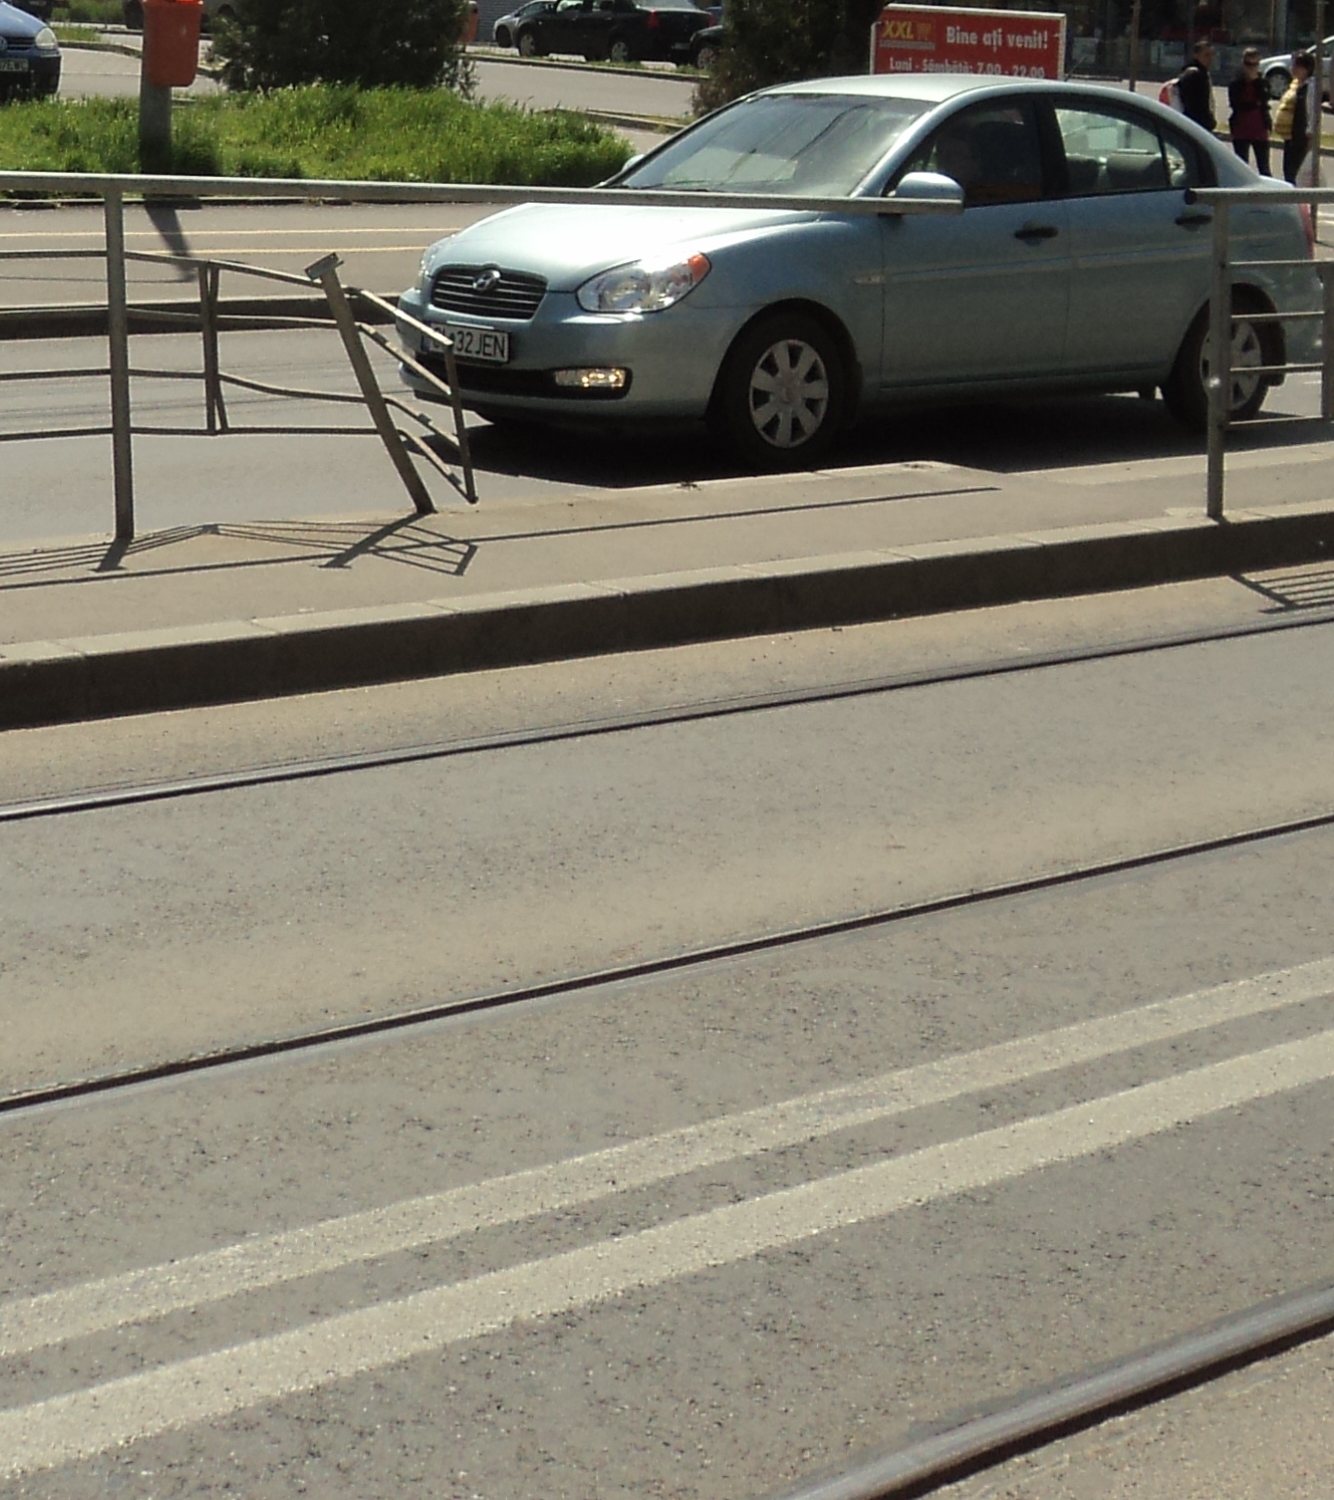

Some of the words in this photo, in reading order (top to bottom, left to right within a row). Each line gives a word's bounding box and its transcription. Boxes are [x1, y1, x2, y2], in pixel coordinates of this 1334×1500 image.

[881, 20, 914, 40] XXL
[946, 26, 977, 44] Bine
[1007, 31, 1048, 50] venit!
[889, 56, 913, 71] Luni
